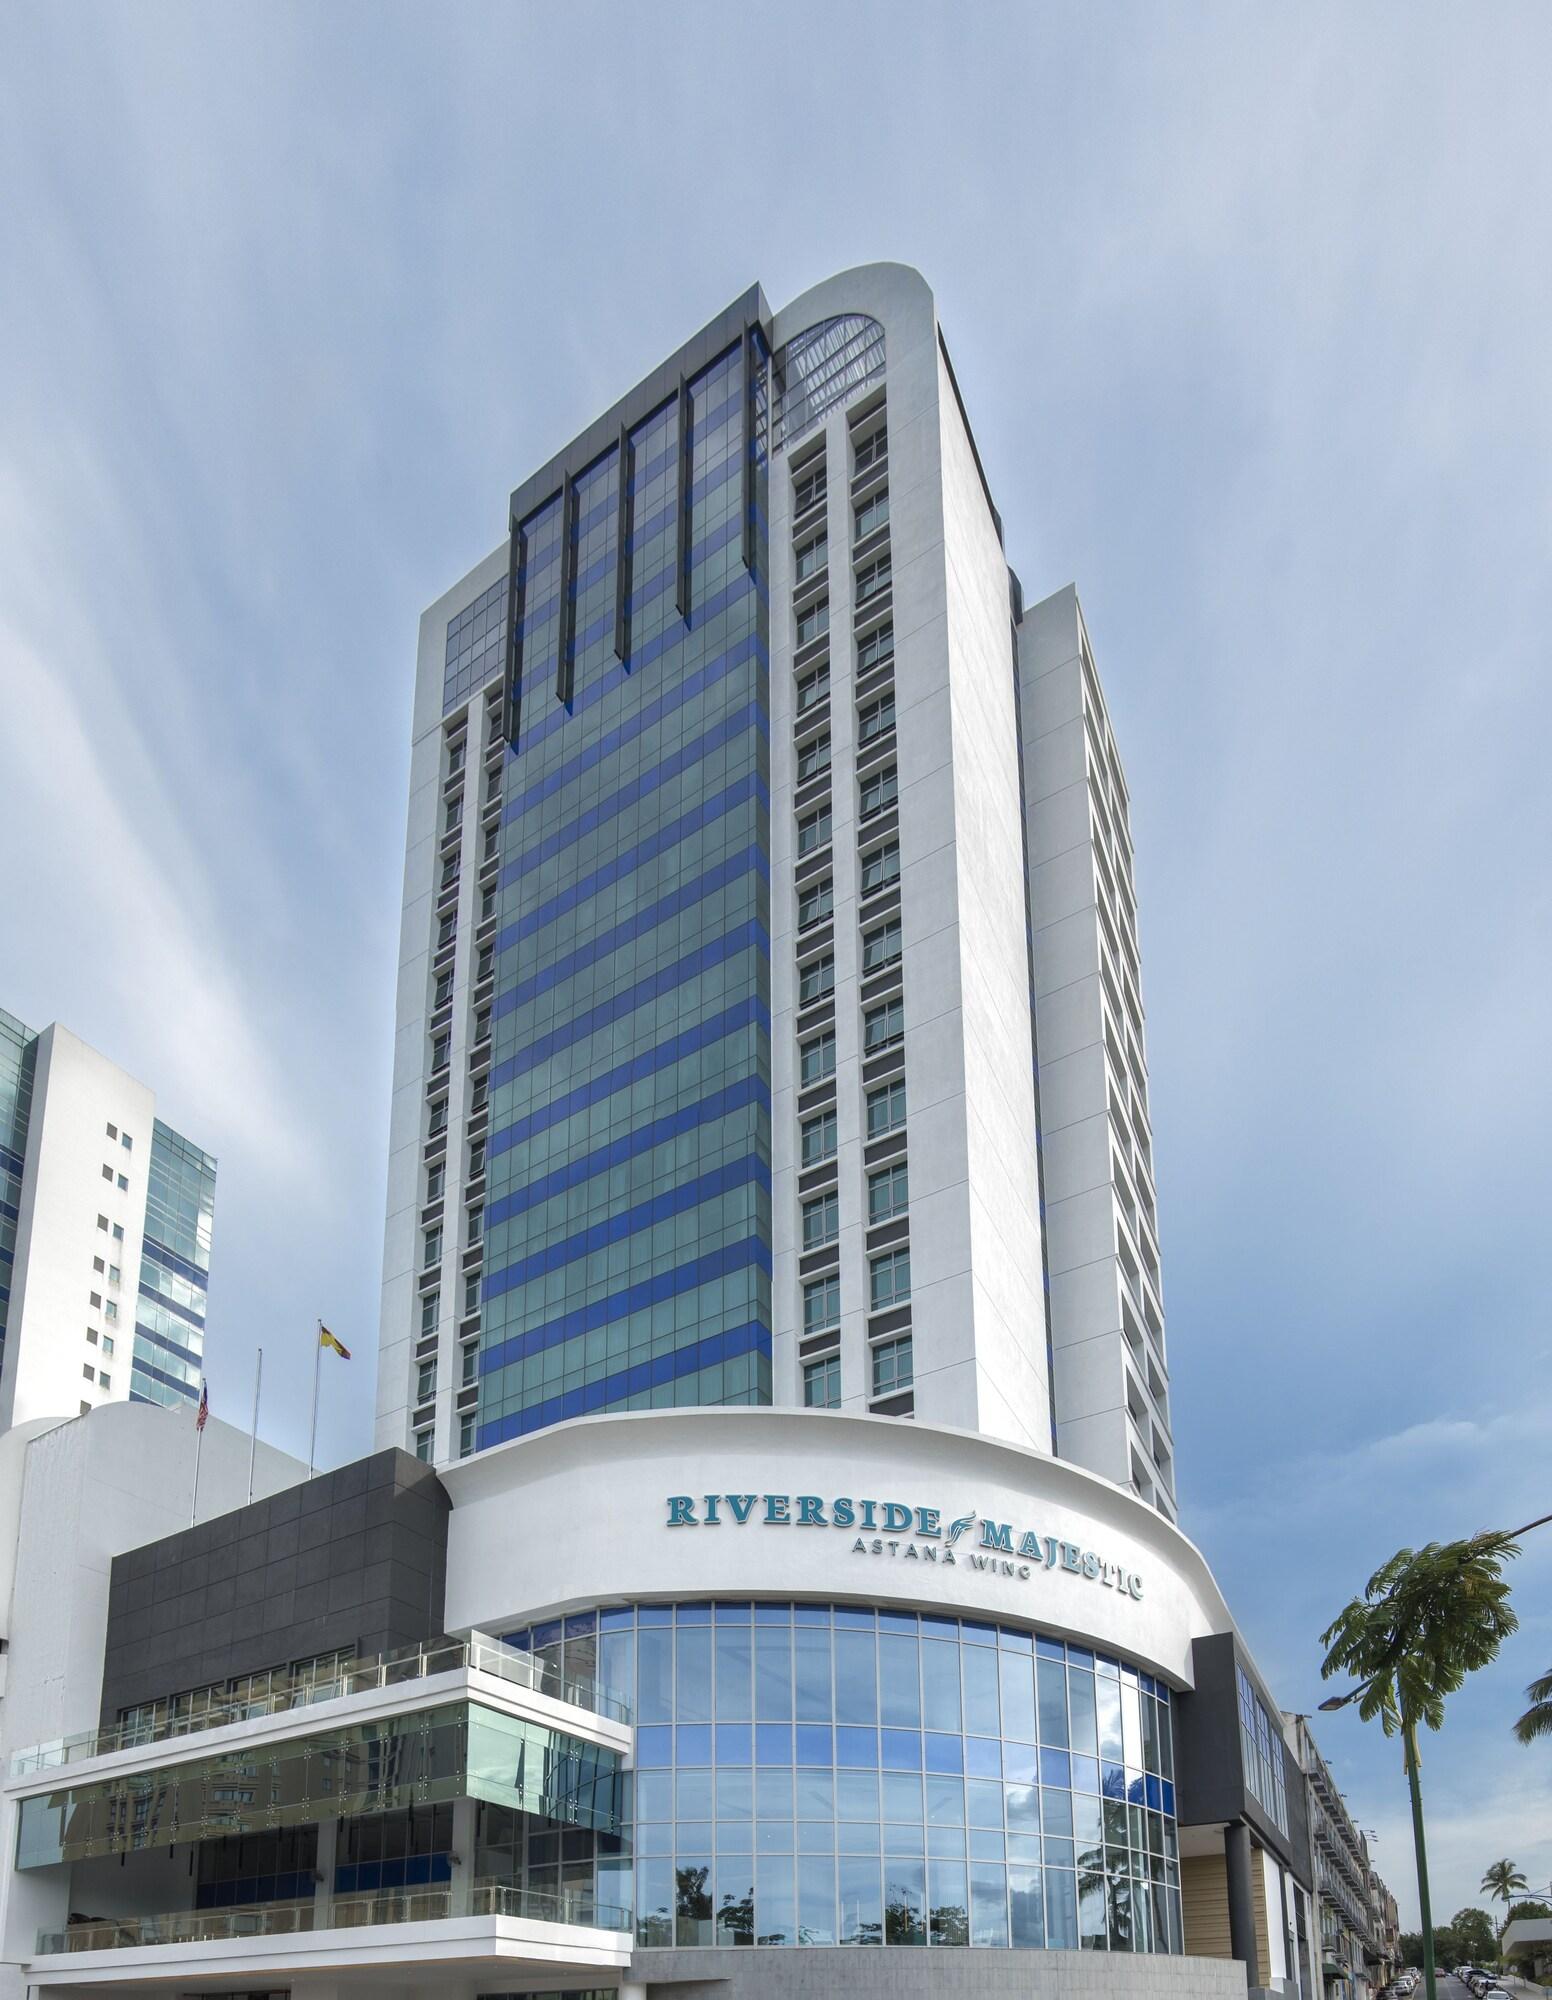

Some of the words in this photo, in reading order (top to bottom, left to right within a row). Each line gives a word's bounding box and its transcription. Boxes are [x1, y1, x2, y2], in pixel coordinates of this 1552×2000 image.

[667, 1494, 942, 1537] RIVERSIDE
[980, 1518, 1145, 1600] MAJESTIC
[852, 1537, 956, 1564] ASTANA
[969, 1553, 1031, 1580] WING
